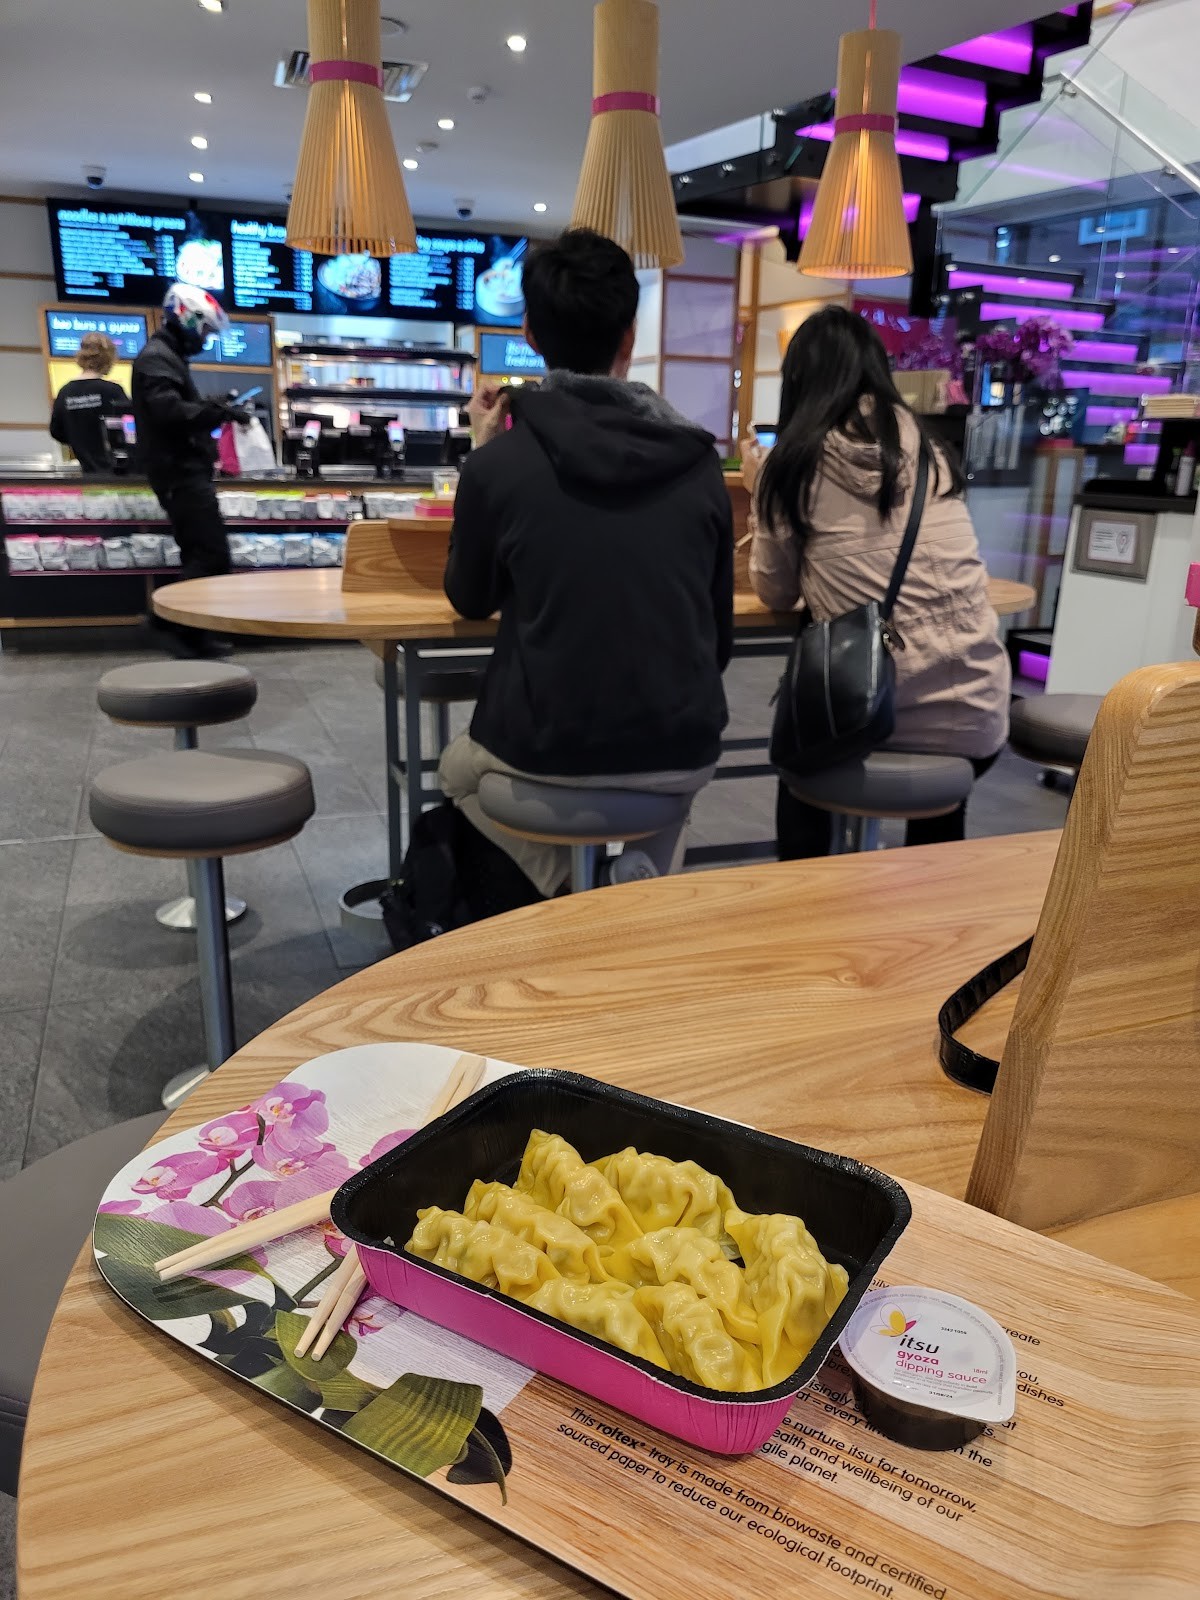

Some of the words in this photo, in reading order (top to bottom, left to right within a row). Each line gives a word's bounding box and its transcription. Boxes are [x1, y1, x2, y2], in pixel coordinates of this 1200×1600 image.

[900, 1334, 940, 1354] itsu
[1002, 1326, 1041, 1346] reate
[897, 1350, 939, 1366] gyoza
[896, 1360, 944, 1378] dipping
[947, 1371, 987, 1384] sauce
[1017, 1382, 1065, 1407] dishes
[824, 1403, 863, 1426] every
[760, 1442, 788, 1459] gile
[788, 1454, 838, 1484] planet.
[793, 1421, 845, 1451] nurture
[847, 1445, 874, 1464] itsu
[877, 1458, 898, 1475] for
[901, 1469, 977, 1513] tomorrow,
[967, 1449, 993, 1467] the
[772, 1429, 806, 1450] ealth
[809, 1447, 840, 1465] and
[841, 1460, 914, 1502] wellbeing
[917, 1497, 935, 1509] of
[936, 1505, 963, 1522] our
[557, 1424, 611, 1454] sourced
[607, 1450, 652, 1476] paper
[652, 1470, 667, 1484] to
[667, 1480, 717, 1510] reduce
[719, 1506, 746, 1524] our
[747, 1520, 825, 1564] ecological
[825, 1556, 894, 1600] footprint.
[570, 1407, 596, 1427] This
[648, 1447, 676, 1468] tray
[676, 1460, 690, 1474] is
[690, 1470, 733, 1496] made
[735, 1489, 770, 1515] from
[771, 1506, 842, 1550] biowaste
[845, 1545, 880, 1567] and
[880, 1562, 947, 1600] certified
